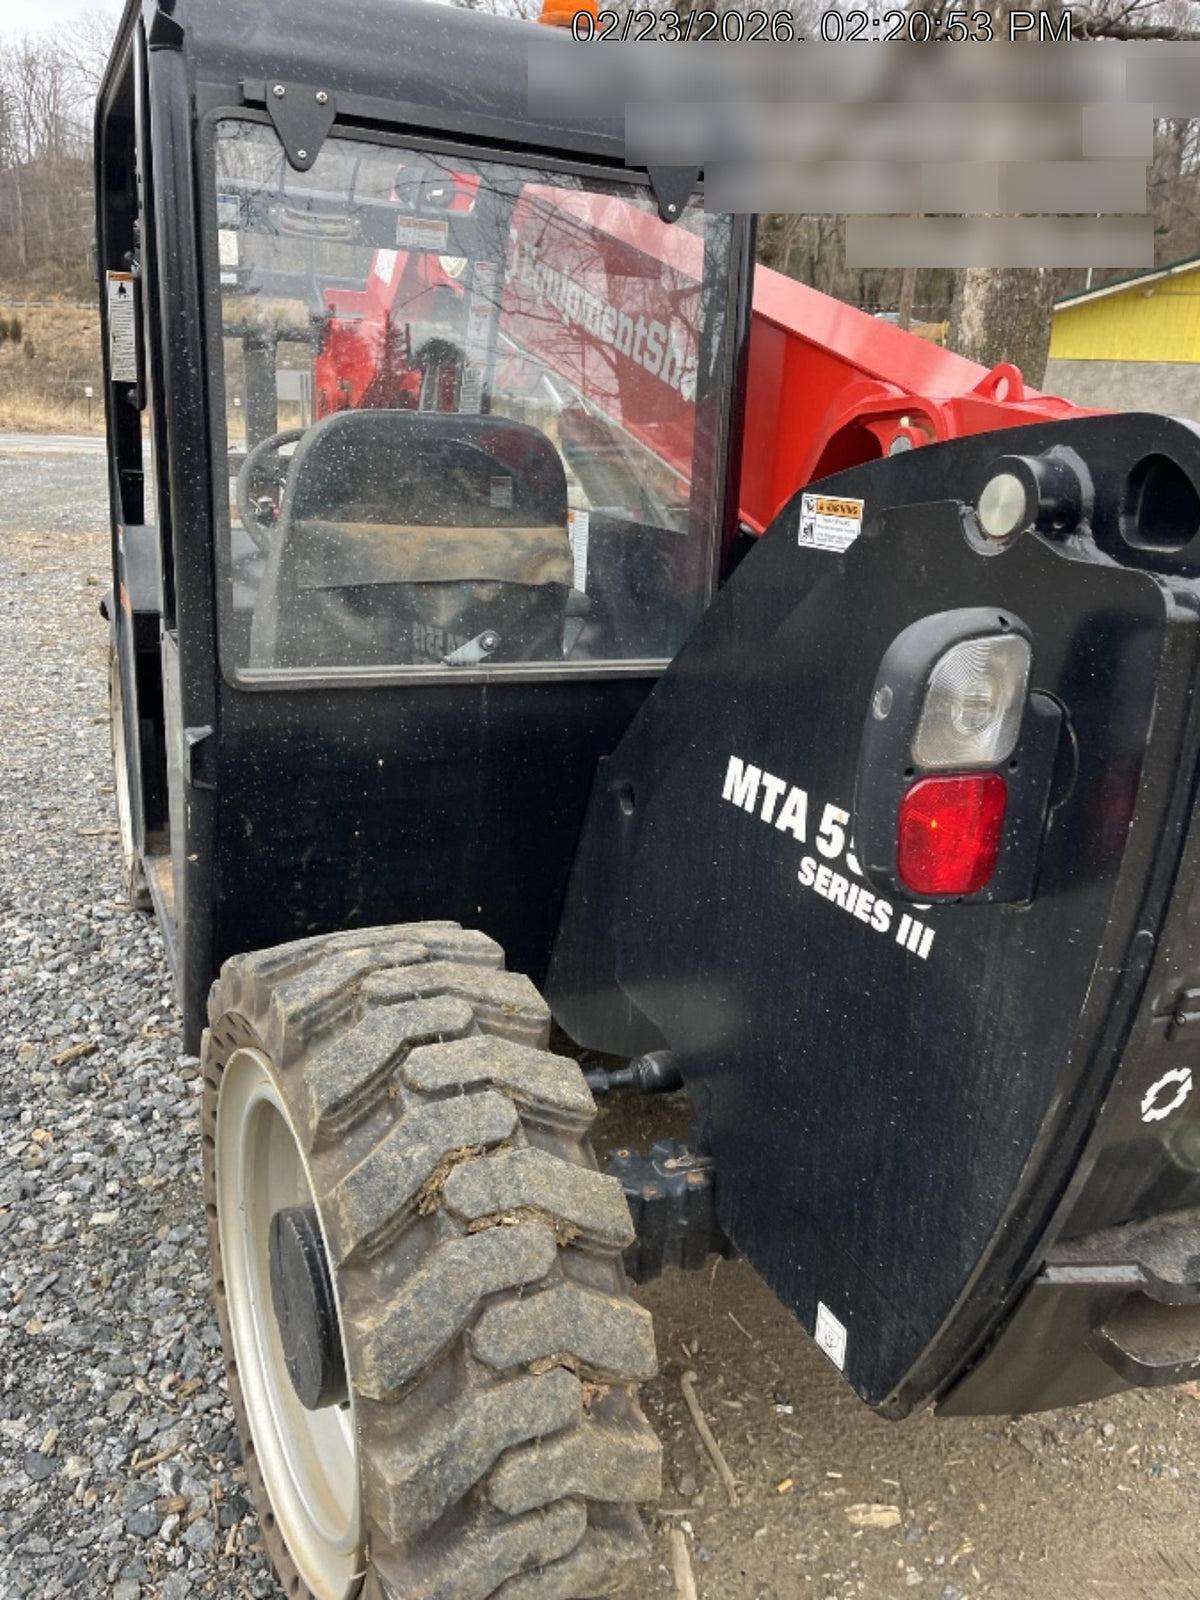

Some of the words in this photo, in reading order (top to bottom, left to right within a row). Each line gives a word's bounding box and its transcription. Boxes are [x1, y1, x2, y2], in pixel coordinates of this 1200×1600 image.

[721, 754, 808, 843] MTA
[798, 856, 893, 932] SERIES
[895, 913, 936, 960] III
